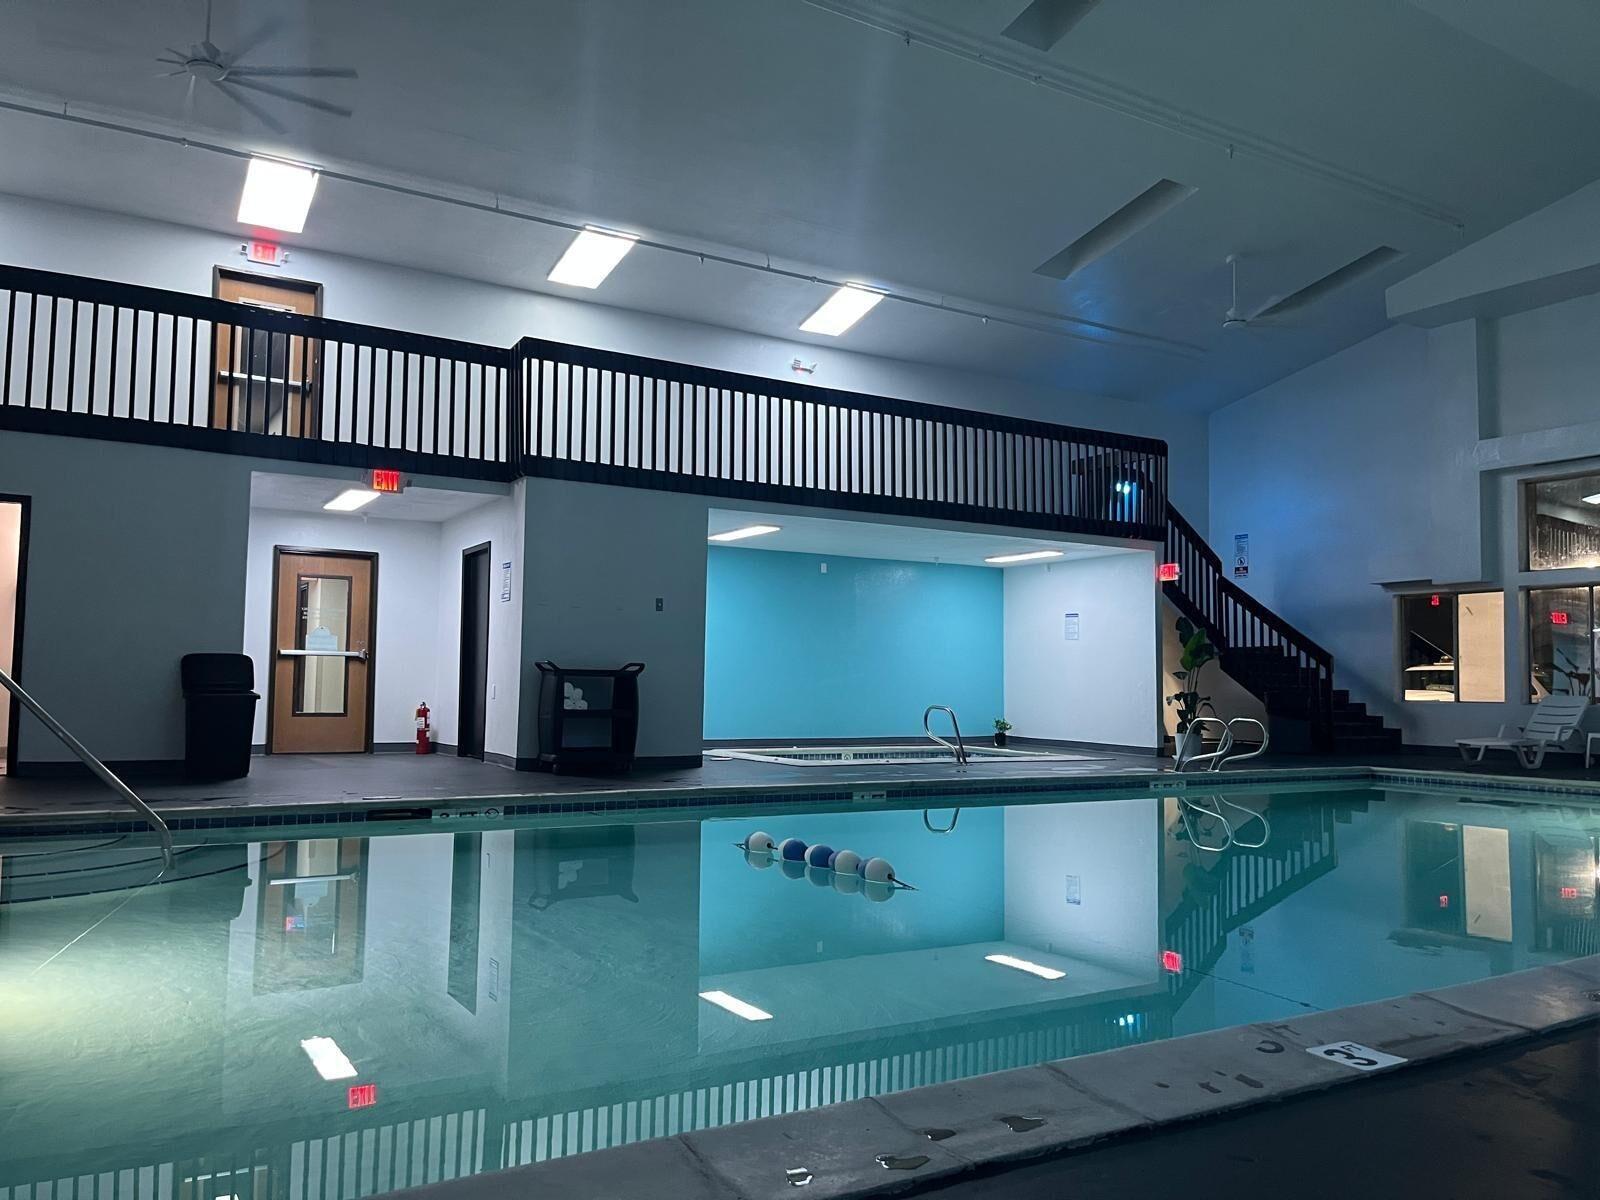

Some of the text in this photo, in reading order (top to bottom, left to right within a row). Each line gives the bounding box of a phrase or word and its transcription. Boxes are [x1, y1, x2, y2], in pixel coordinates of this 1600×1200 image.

[374, 470, 399, 490] EXIT
[1324, 1044, 1378, 1066] 3 FT
